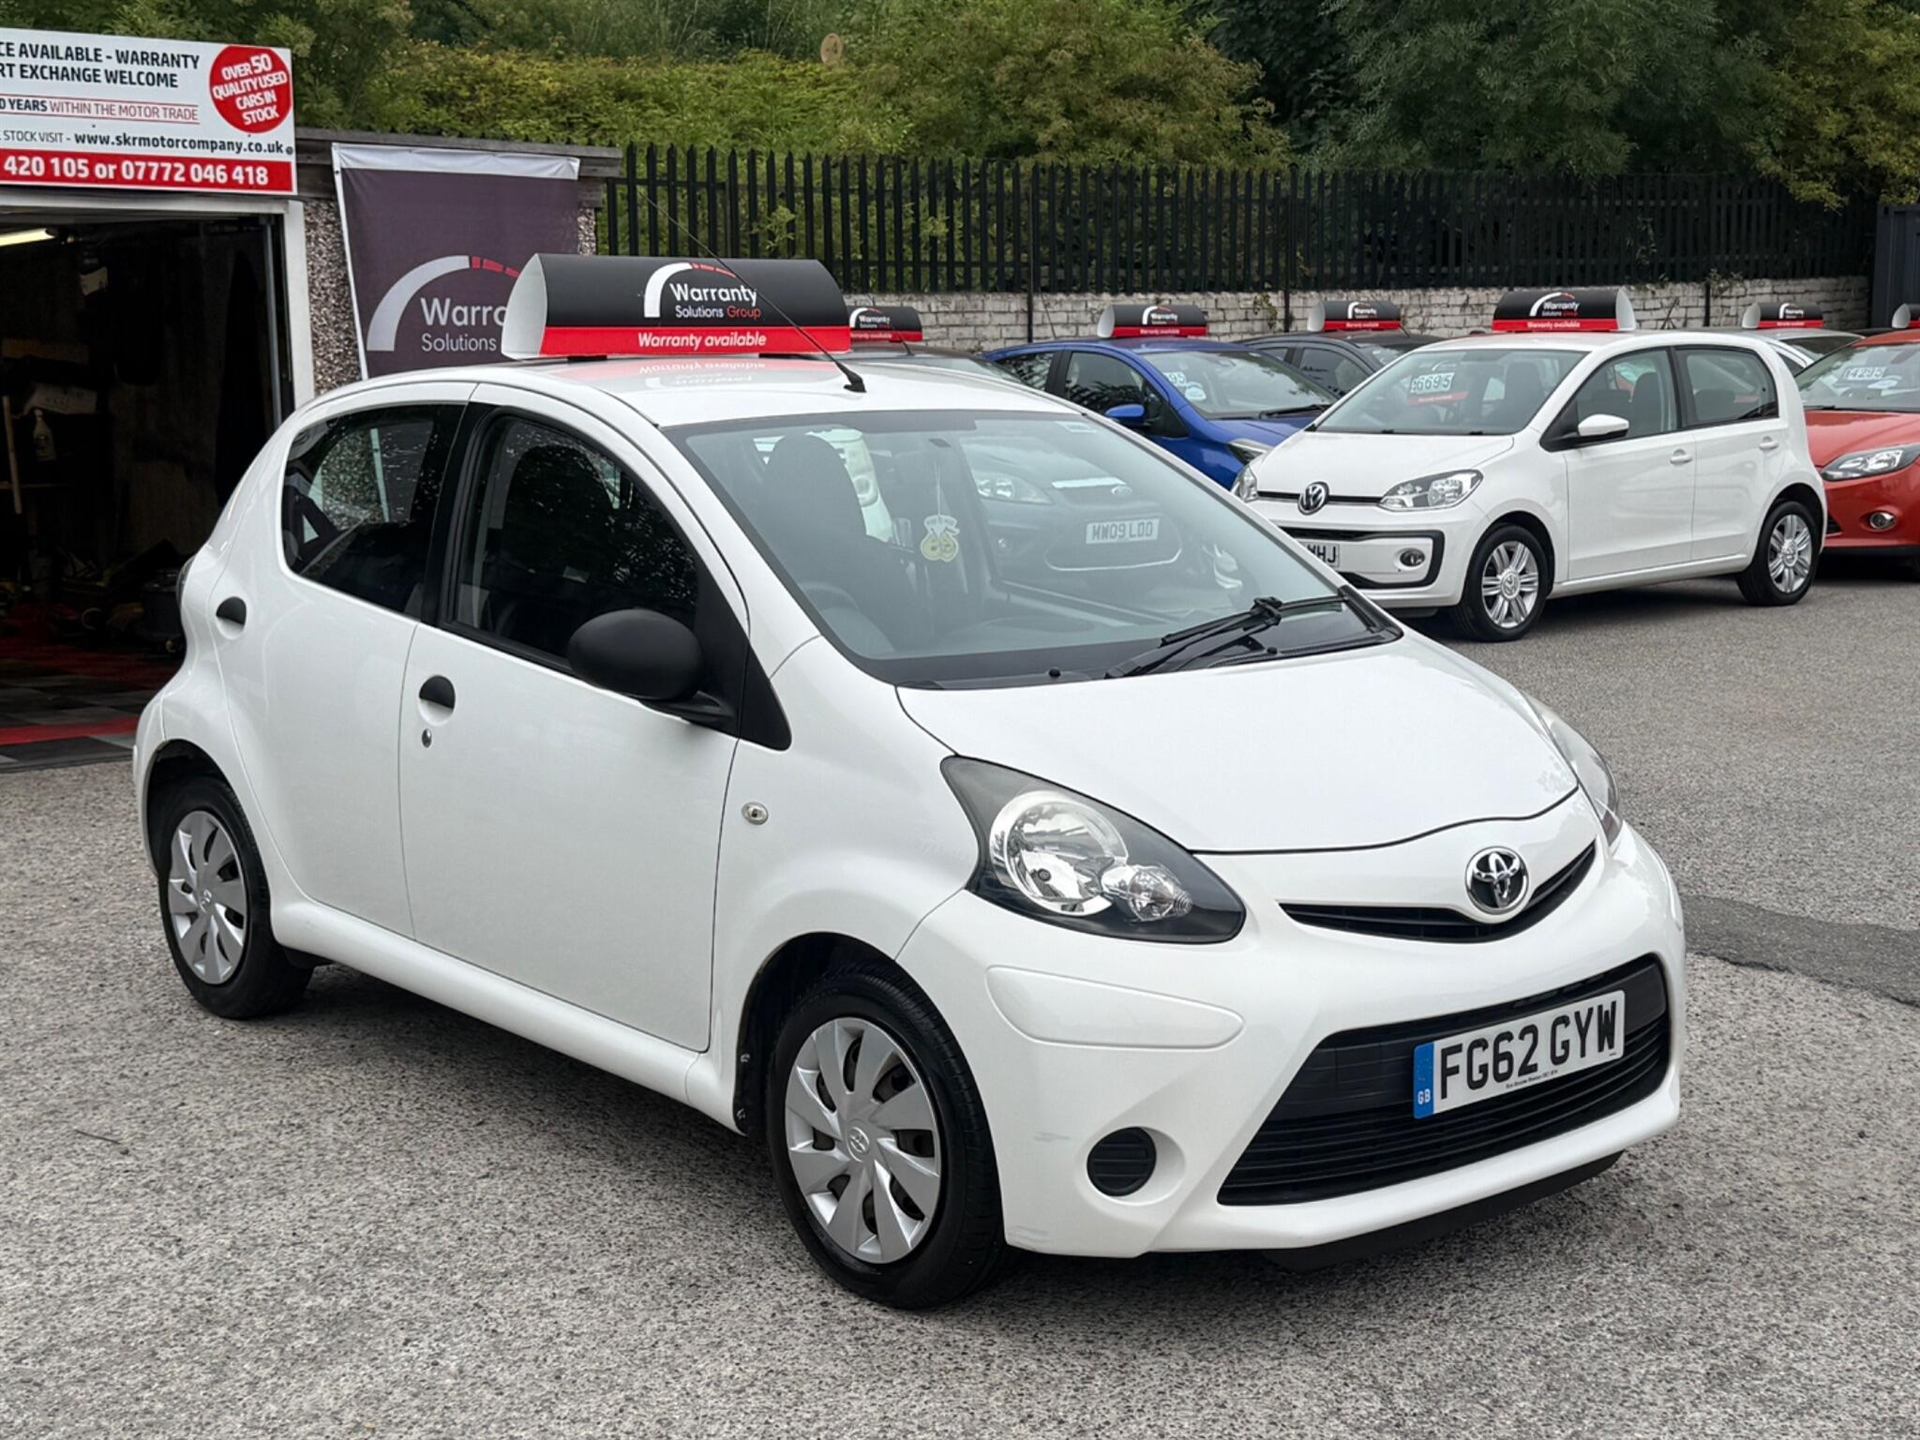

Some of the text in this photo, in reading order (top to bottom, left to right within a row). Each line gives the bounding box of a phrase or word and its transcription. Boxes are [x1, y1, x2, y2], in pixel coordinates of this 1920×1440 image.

[19, 43, 103, 62] AVAILABLE
[115, 49, 200, 69] WARRANTY
[222, 53, 273, 80] OVER 50
[20, 64, 102, 83] EXCHANGE
[104, 69, 179, 88] WELCOME
[212, 71, 287, 100] QUALITY USED
[9, 99, 48, 112] YEARS
[50, 101, 91, 114] WITHIN
[94, 103, 117, 116] THE
[118, 105, 160, 119] MOTOR
[163, 107, 199, 120] TRADE
[236, 89, 277, 110] CARS IN
[242, 105, 280, 125] STOCK
[3, 130, 37, 142] STOCK
[39, 132, 64, 143] VISIT
[75, 132, 284, 154] www.skrmotorcompany.co.uk
[3, 155, 269, 185] 420 105 or 07772 046 418
[669, 283, 758, 307] Warranty
[675, 305, 762, 319] Solutions Group
[1543, 301, 1580, 311] Warranty
[1527, 321, 1553, 330] Warranty
[421, 333, 497, 351] Solutions
[638, 332, 767, 351] Warranty available
[1440, 1000, 1617, 1100] FG62 GYW
[1417, 1089, 1431, 1105] GB
